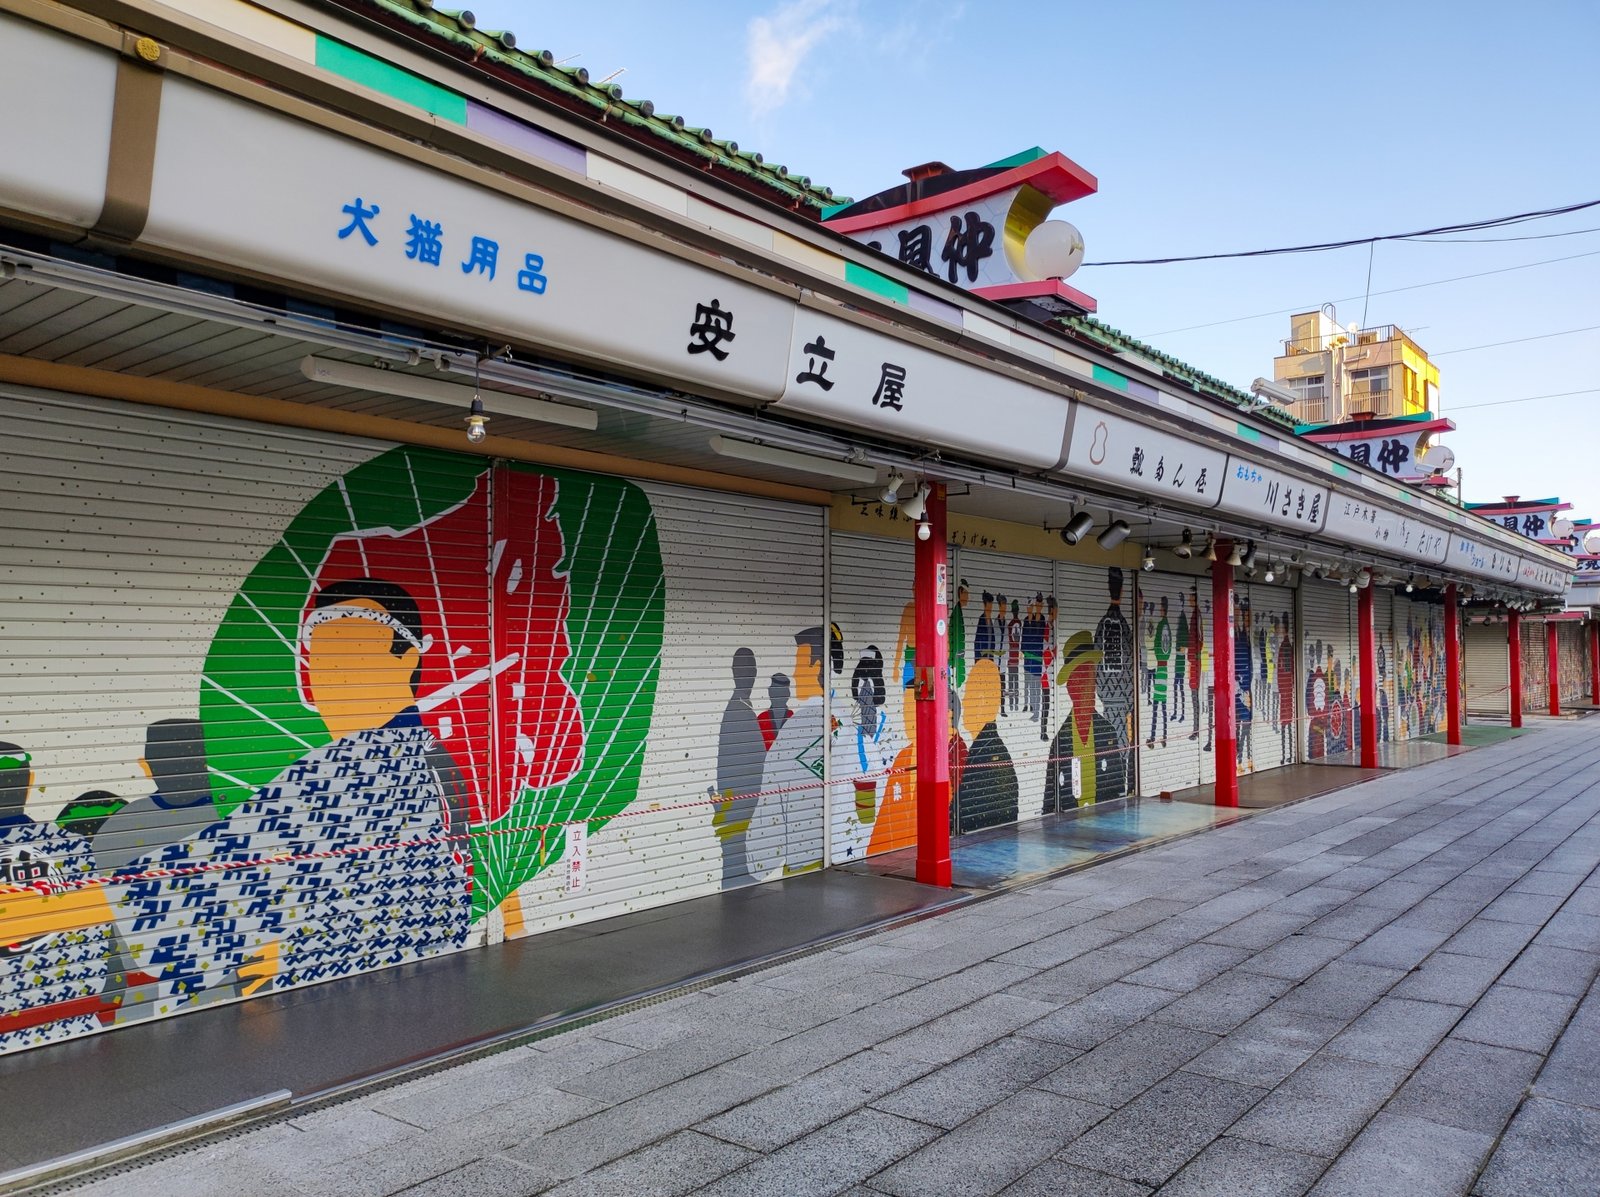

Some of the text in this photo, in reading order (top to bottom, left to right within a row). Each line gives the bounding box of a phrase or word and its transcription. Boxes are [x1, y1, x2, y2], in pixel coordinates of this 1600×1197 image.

[338, 197, 548, 296] 犬猫用品
[687, 299, 908, 412] 安立屋
[1236, 464, 1262, 483] おもちゃ
[860, 503, 912, 522] 三味線
[1264, 480, 1321, 523] 川さき屋
[572, 830, 581, 888] 立入禁止
